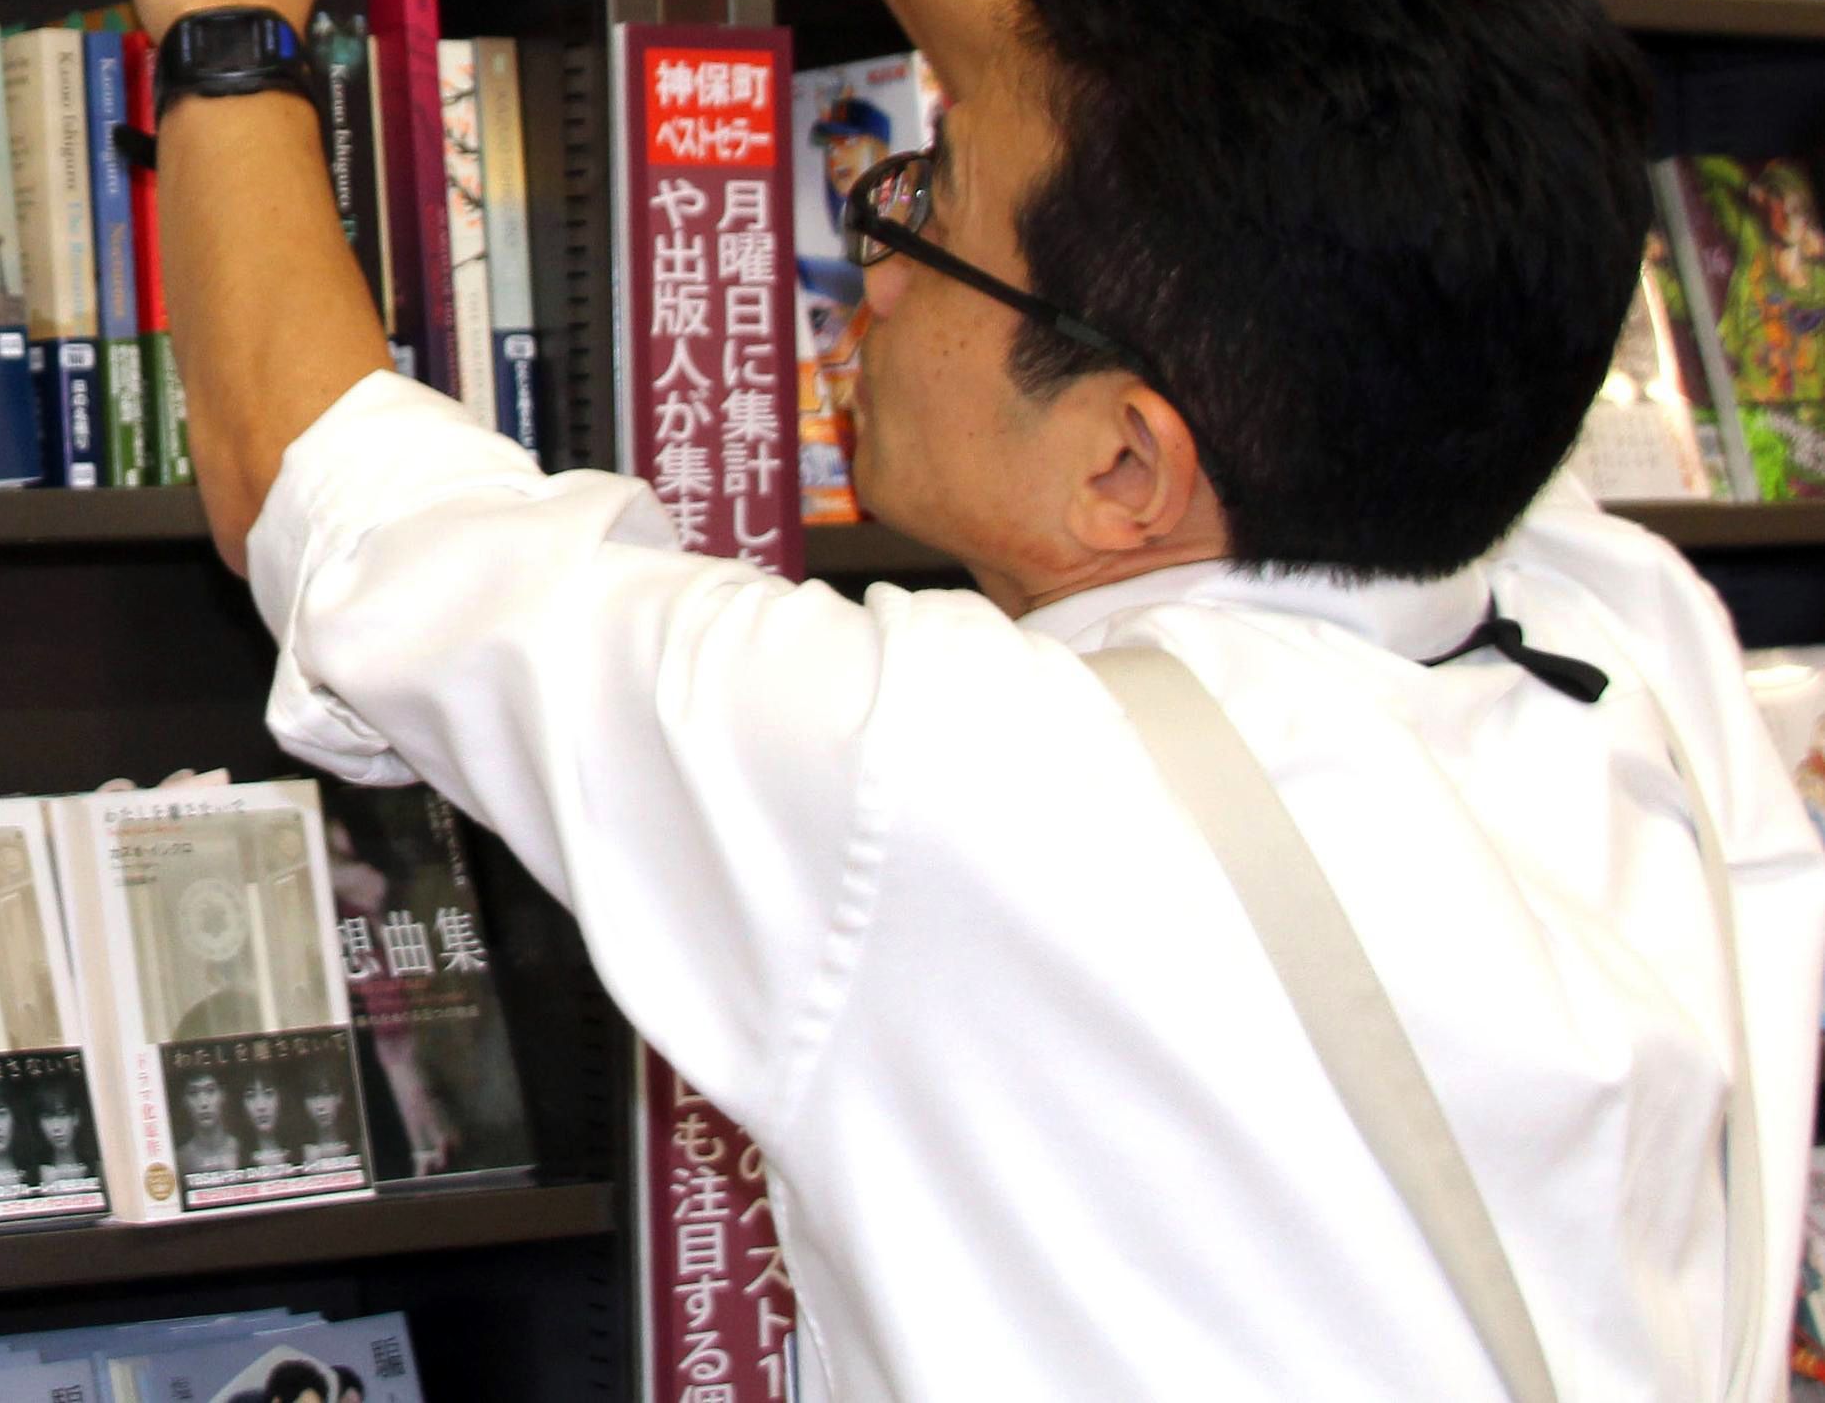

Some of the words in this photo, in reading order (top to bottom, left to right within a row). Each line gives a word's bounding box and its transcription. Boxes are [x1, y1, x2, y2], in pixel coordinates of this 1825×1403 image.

[58, 51, 76, 108] Kazuo
[99, 57, 117, 114] Kazuo
[656, 60, 772, 109] 神保町
[61, 114, 79, 192] Ishiguro
[656, 116, 772, 162] ベストセラー
[336, 906, 490, 981] 想曲集
